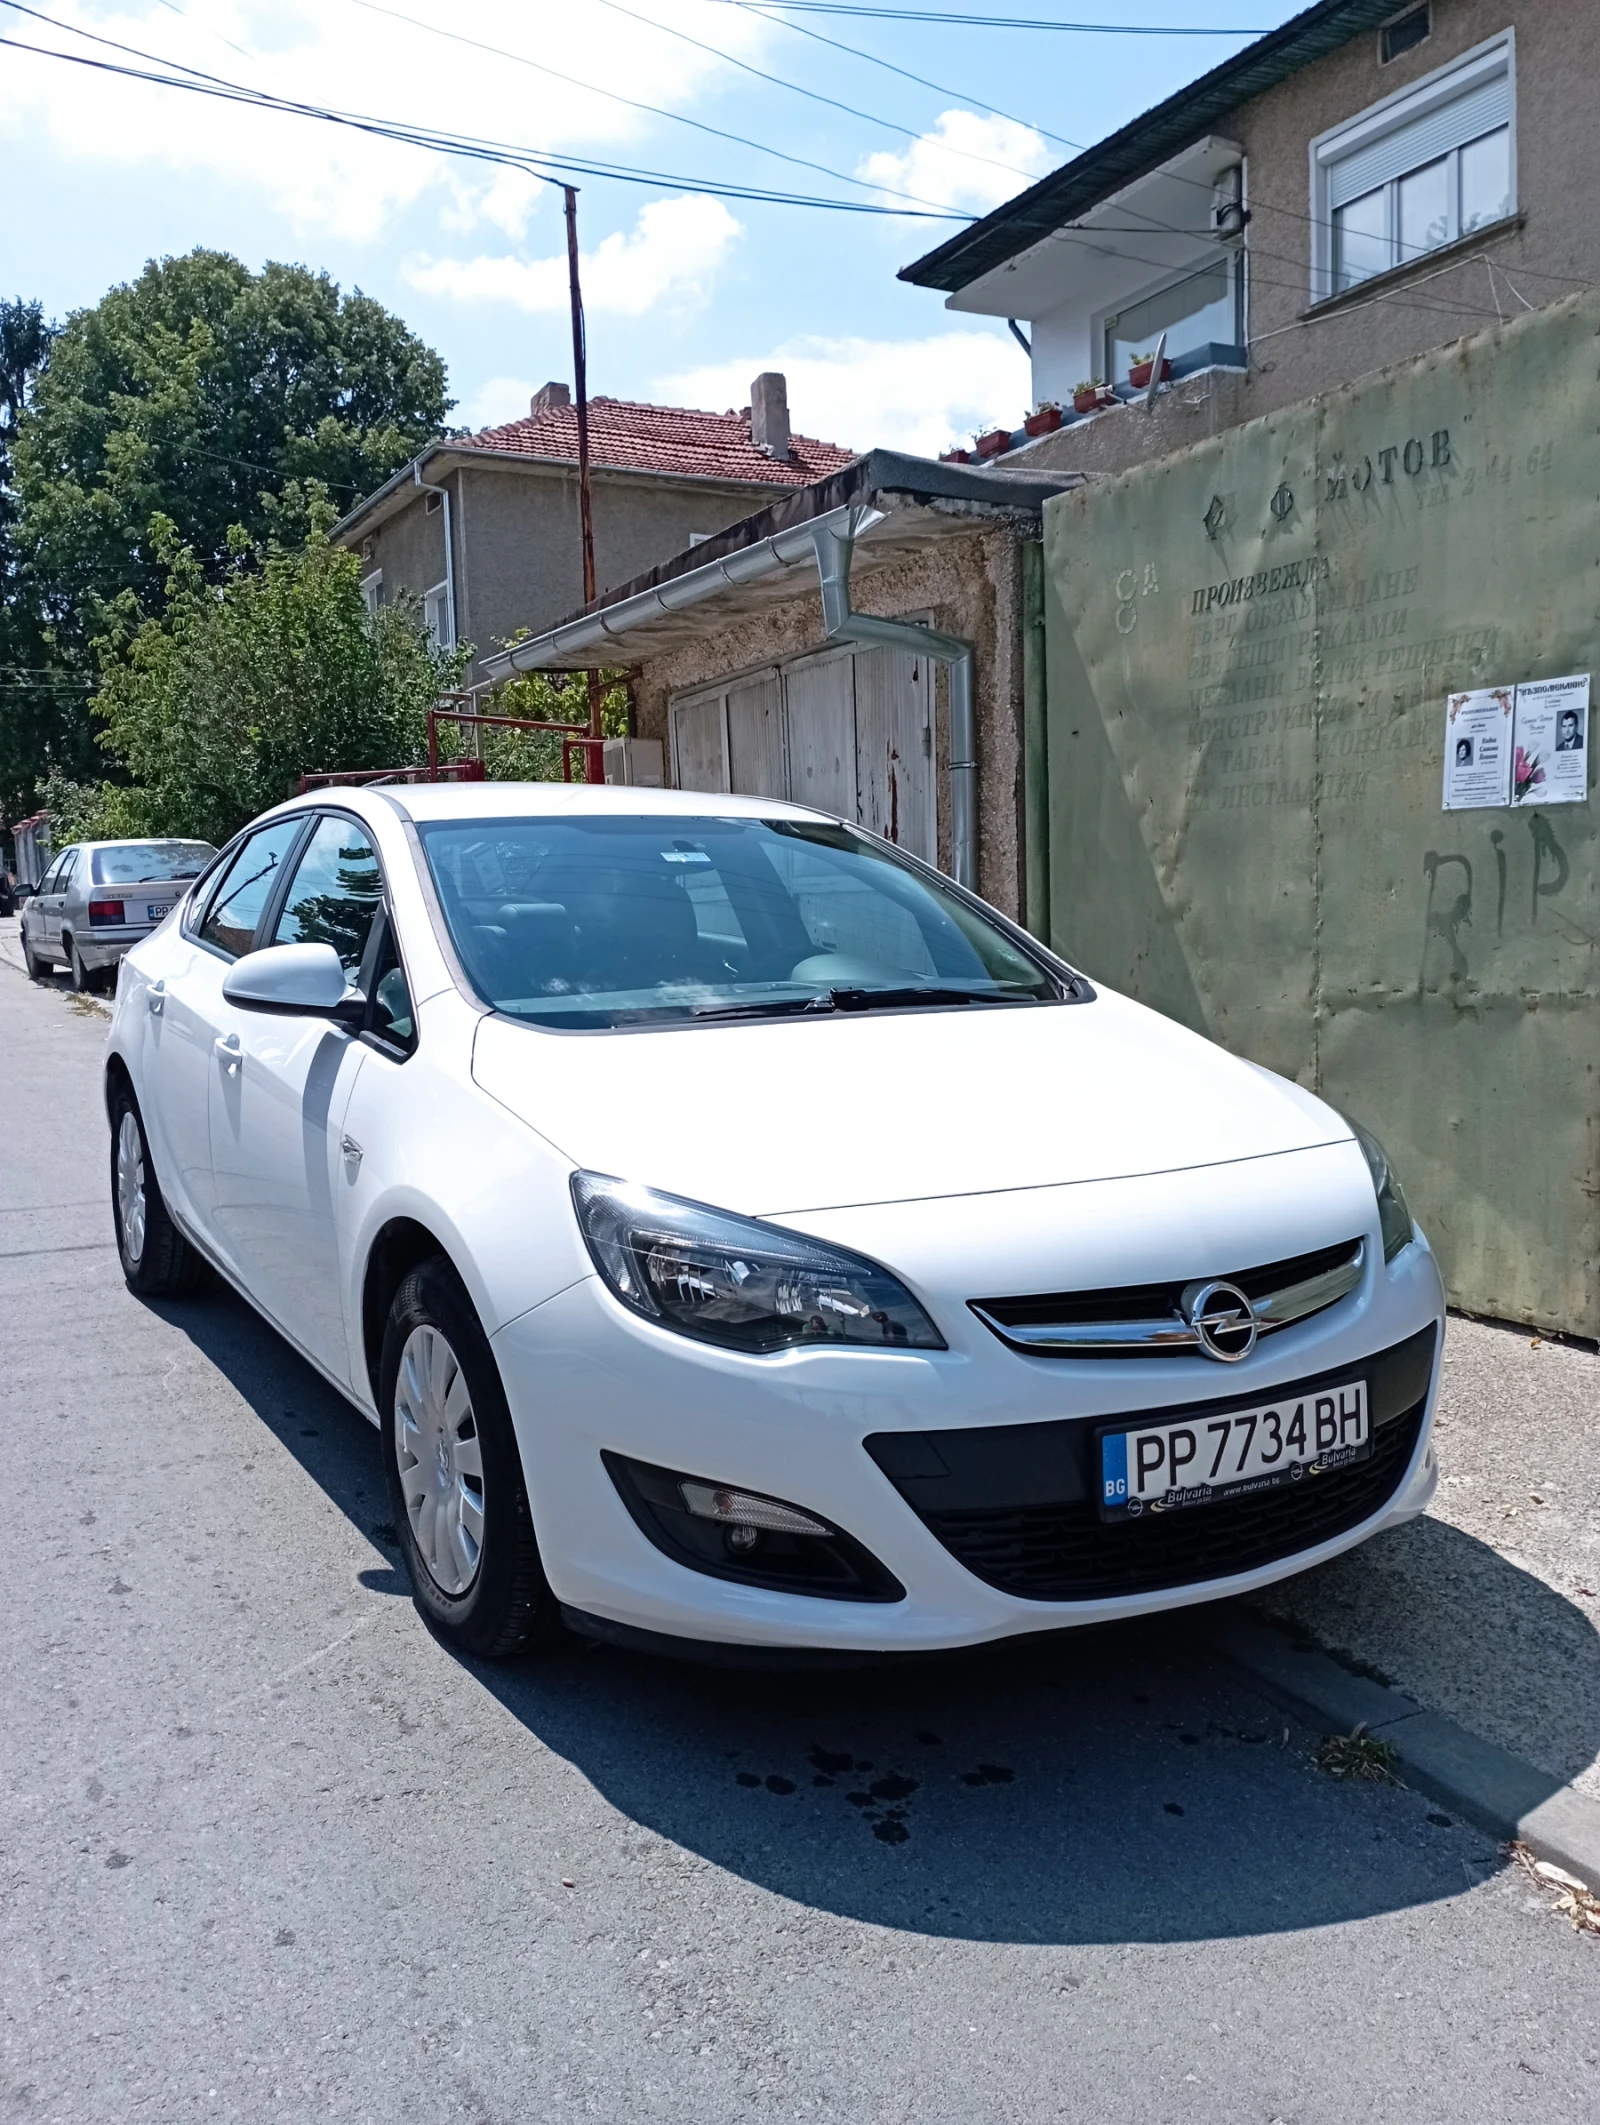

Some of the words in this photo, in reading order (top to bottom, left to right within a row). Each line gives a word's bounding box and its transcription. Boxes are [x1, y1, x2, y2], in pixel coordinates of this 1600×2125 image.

[1245, 566, 1419, 634] ОБЗАВЖДАНЕ
[1297, 607, 1410, 656] РКЛАМИ
[1322, 1446, 1356, 1465] Bulvaria
[1105, 1478, 1126, 1498] BG
[1167, 1485, 1212, 1504] Bulvaria
